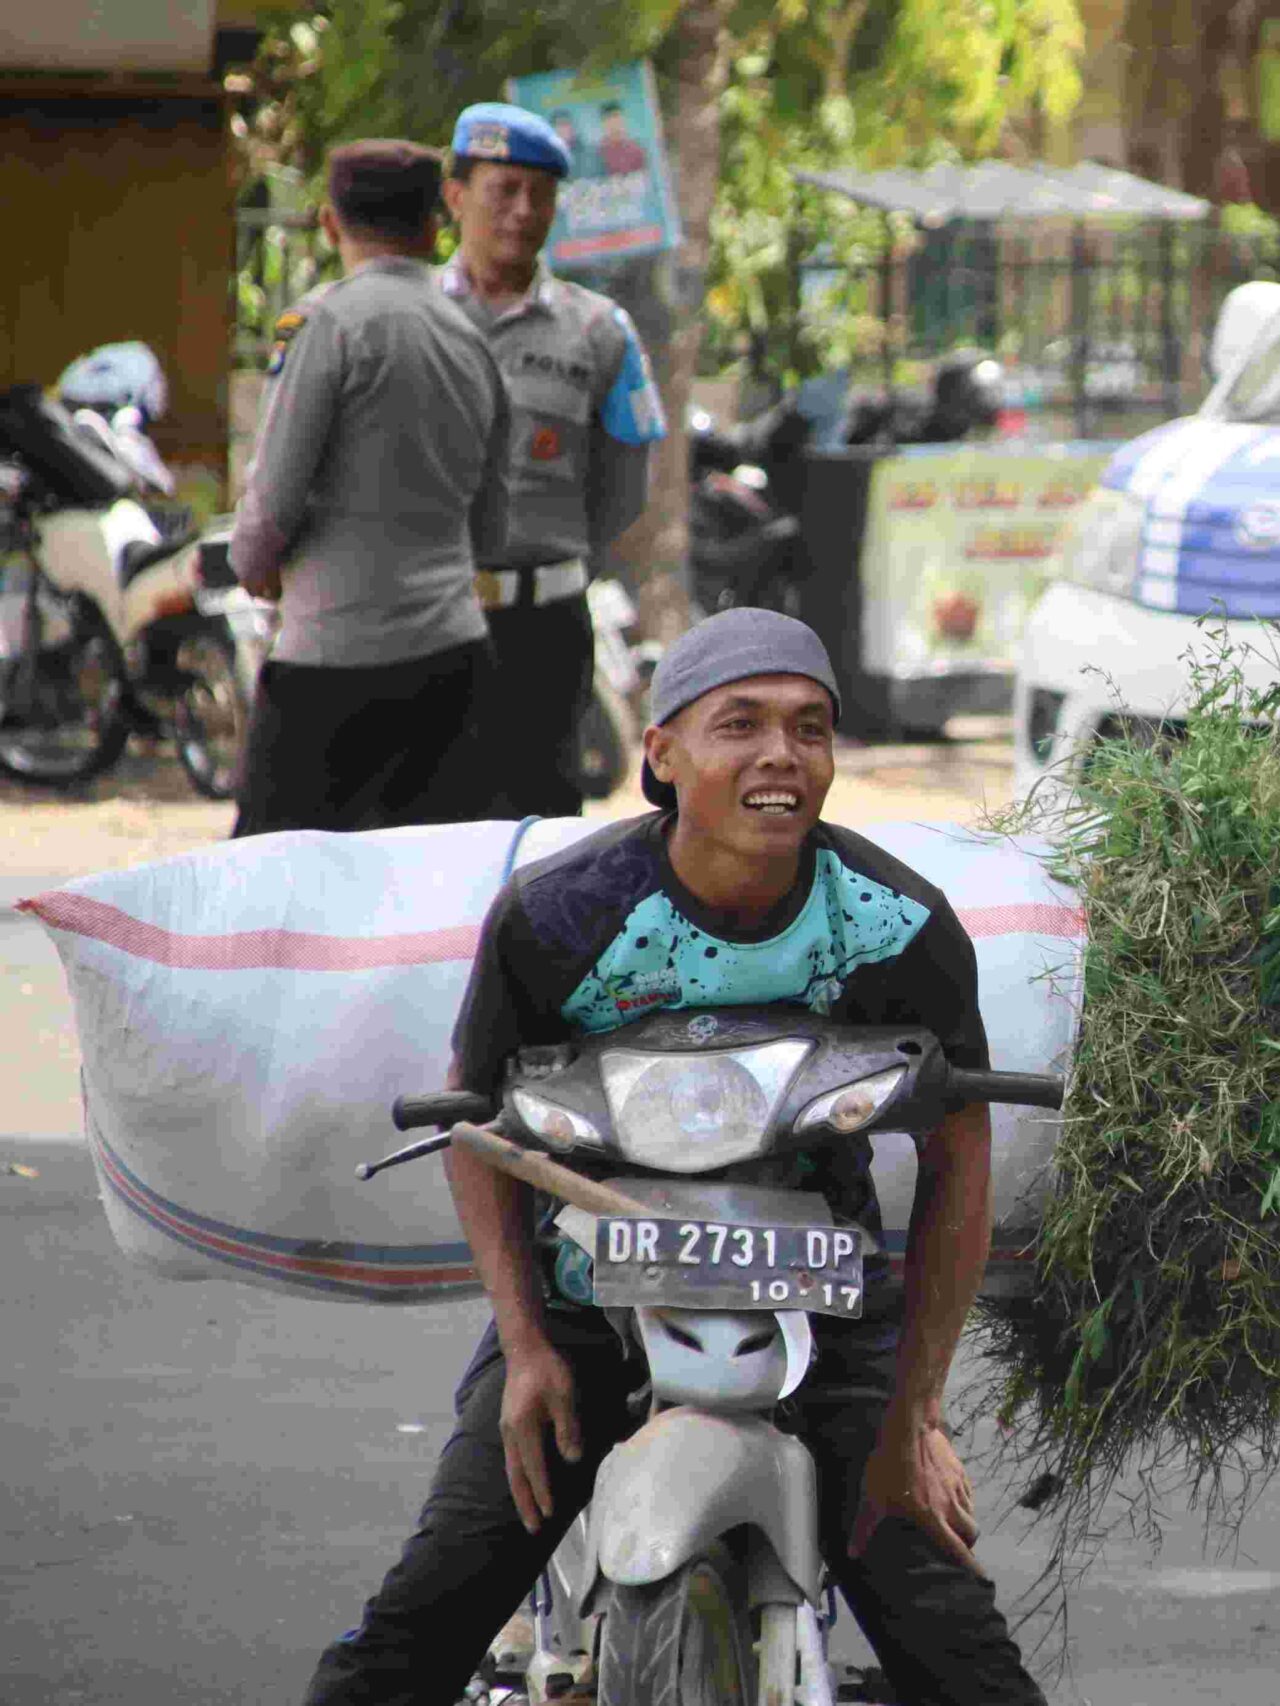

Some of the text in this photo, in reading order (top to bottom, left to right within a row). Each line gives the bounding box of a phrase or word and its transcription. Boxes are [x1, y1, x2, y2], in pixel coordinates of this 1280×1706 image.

[608, 1221, 854, 1269] DR 2731 DP
